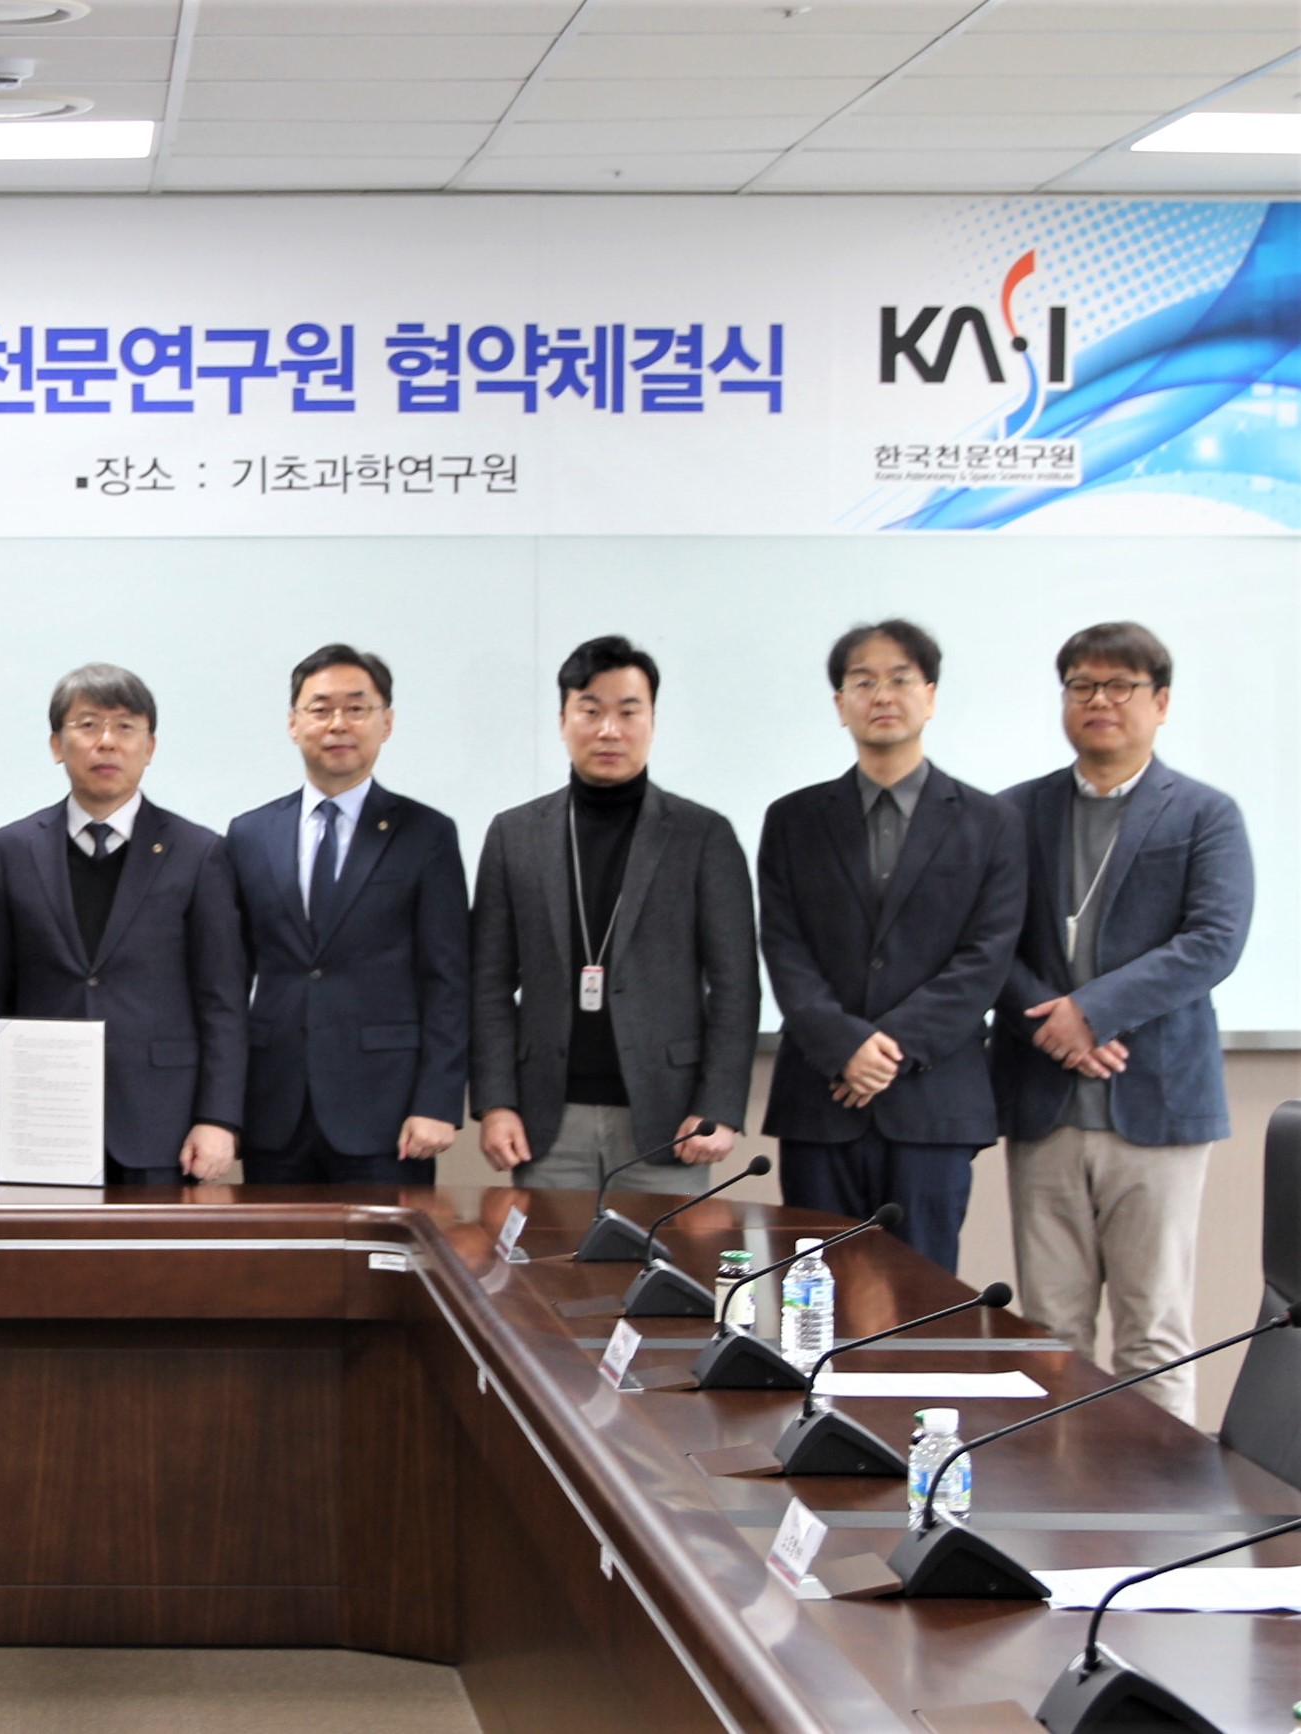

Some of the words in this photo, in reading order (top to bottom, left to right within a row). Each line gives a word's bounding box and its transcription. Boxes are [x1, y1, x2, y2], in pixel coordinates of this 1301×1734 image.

[384, 321, 786, 415] 협약체결식
[232, 453, 519, 495] 기초과학연구원
[875, 444, 1075, 469] 한국천문연구원
